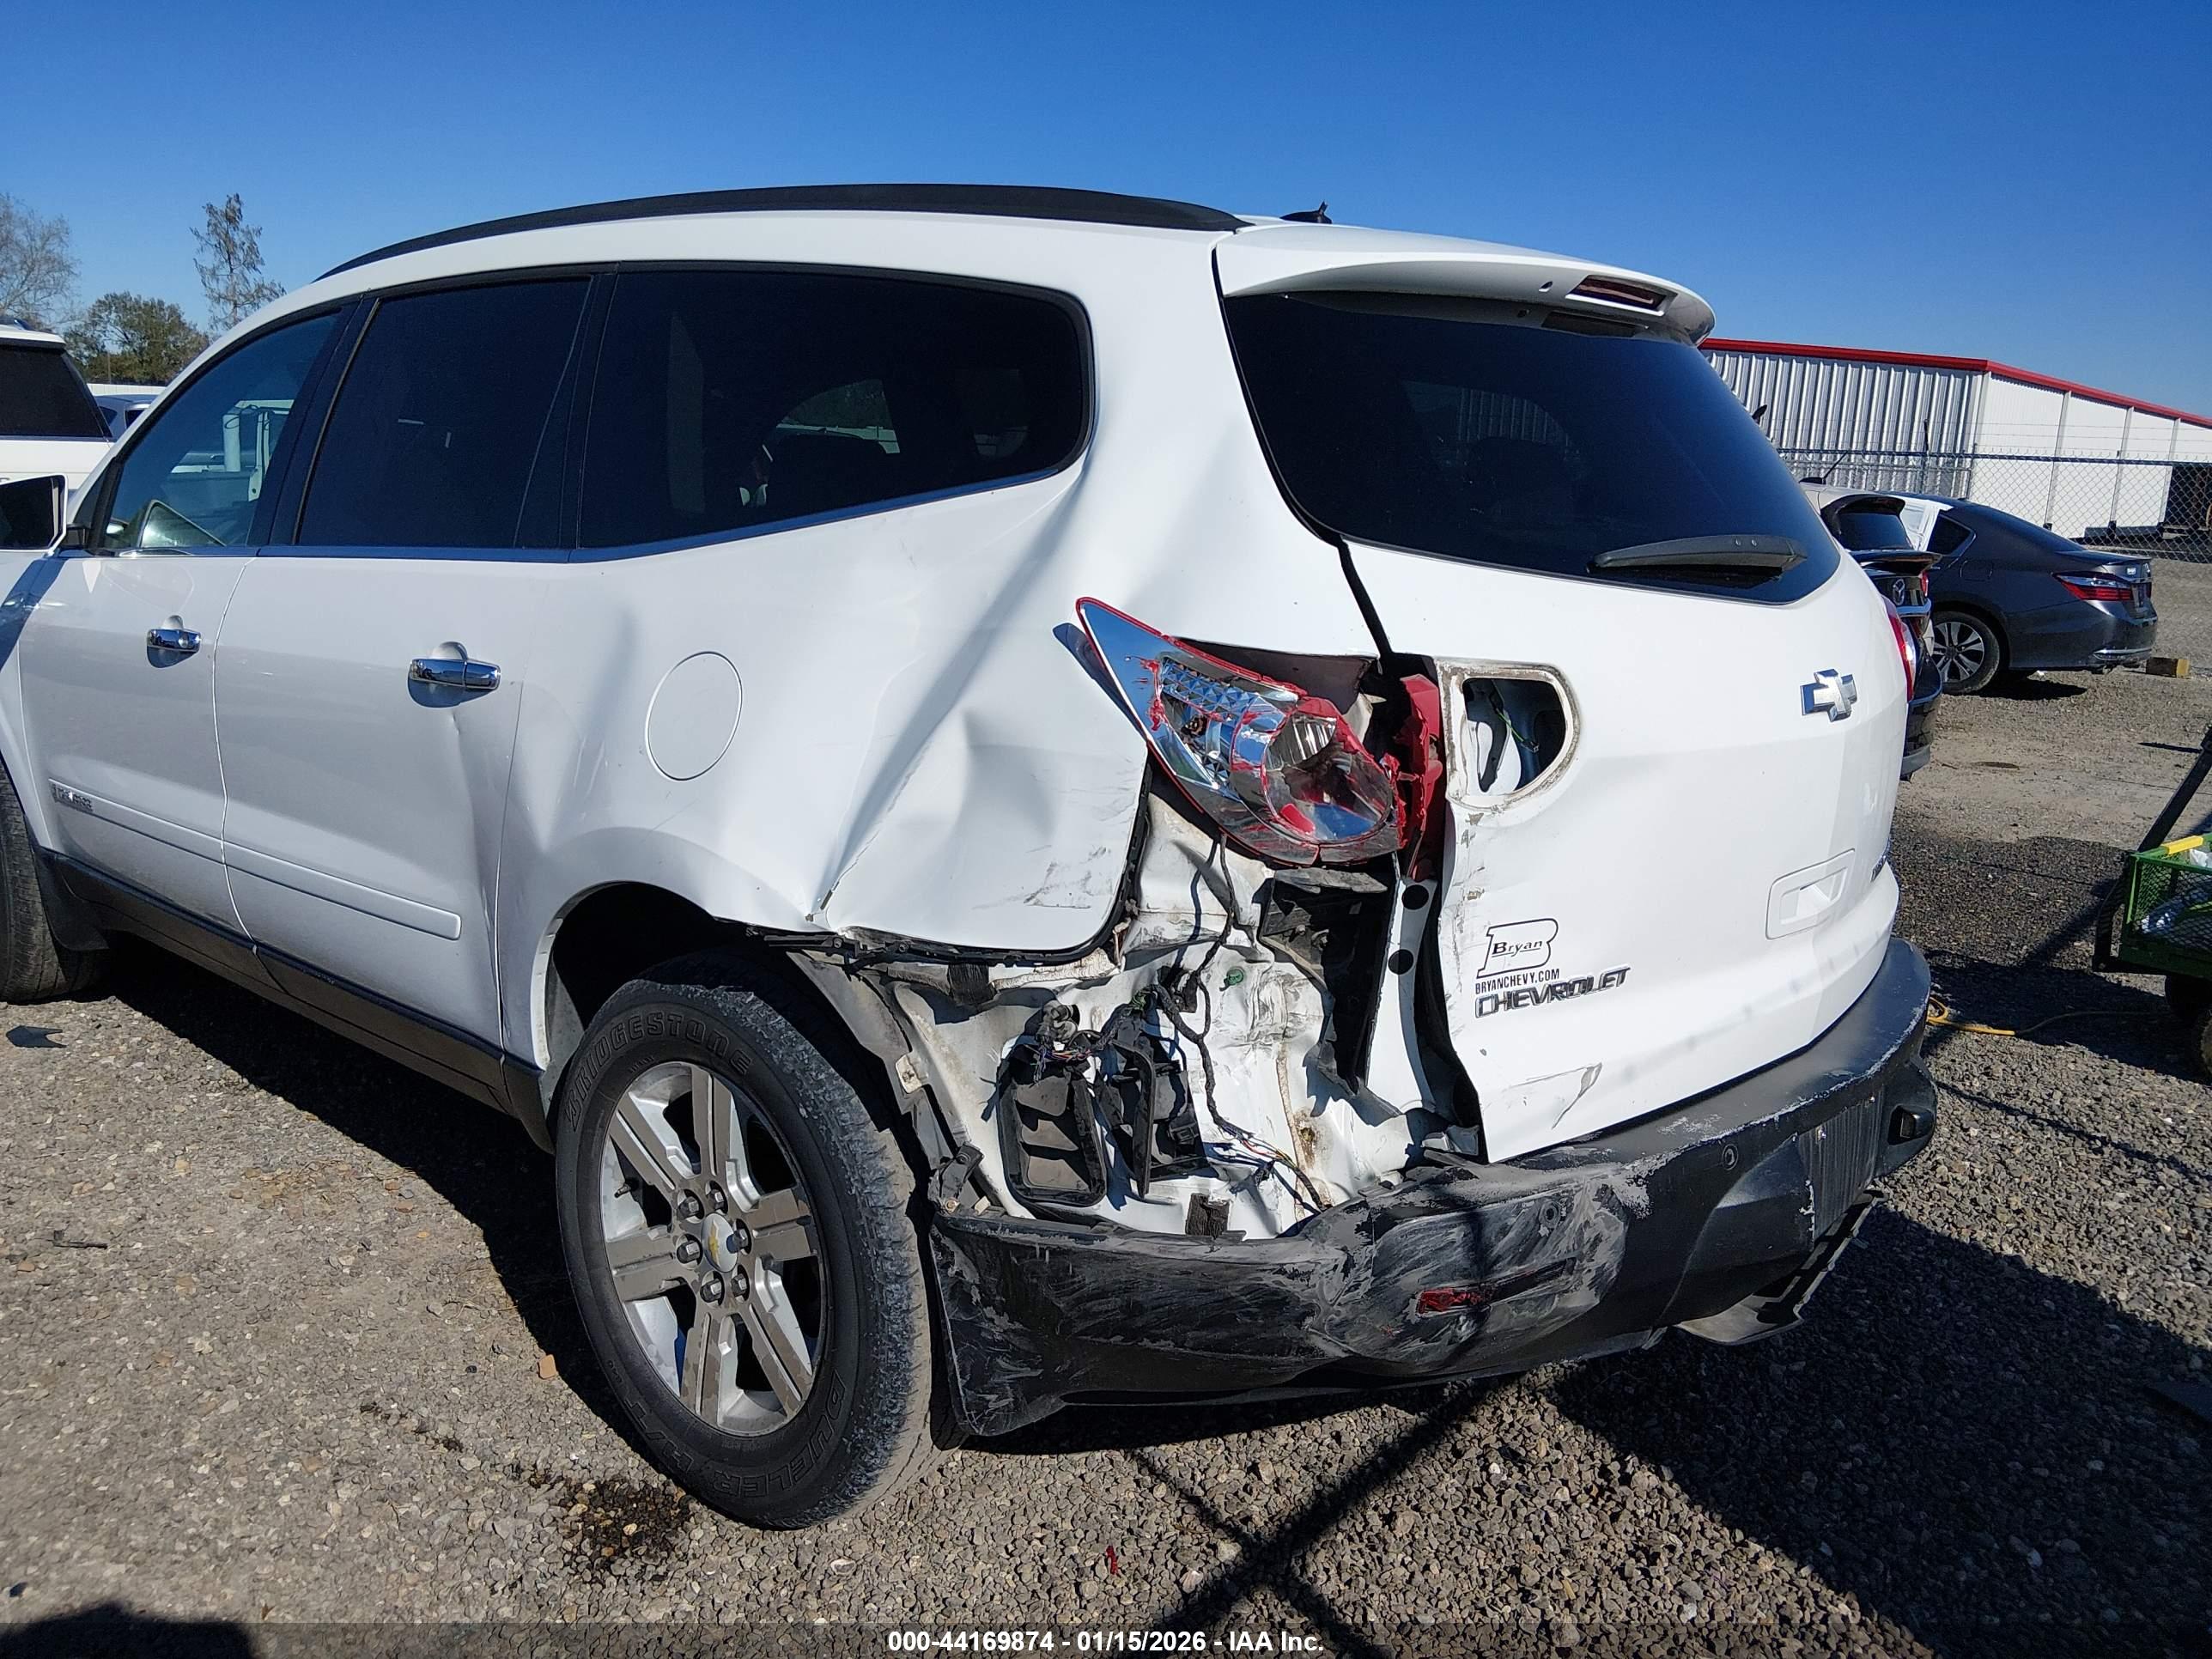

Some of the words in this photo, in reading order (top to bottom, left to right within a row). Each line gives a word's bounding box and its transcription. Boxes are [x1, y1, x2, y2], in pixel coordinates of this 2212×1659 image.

[1492, 939, 1543, 957] Bryan
[1474, 965, 1631, 1018] CHEVROLET
[1475, 968, 1560, 994] BRYANCHEVY.COM
[564, 1011, 753, 1133] BRIDGESTONE
[713, 1369, 847, 1498] DUELER
